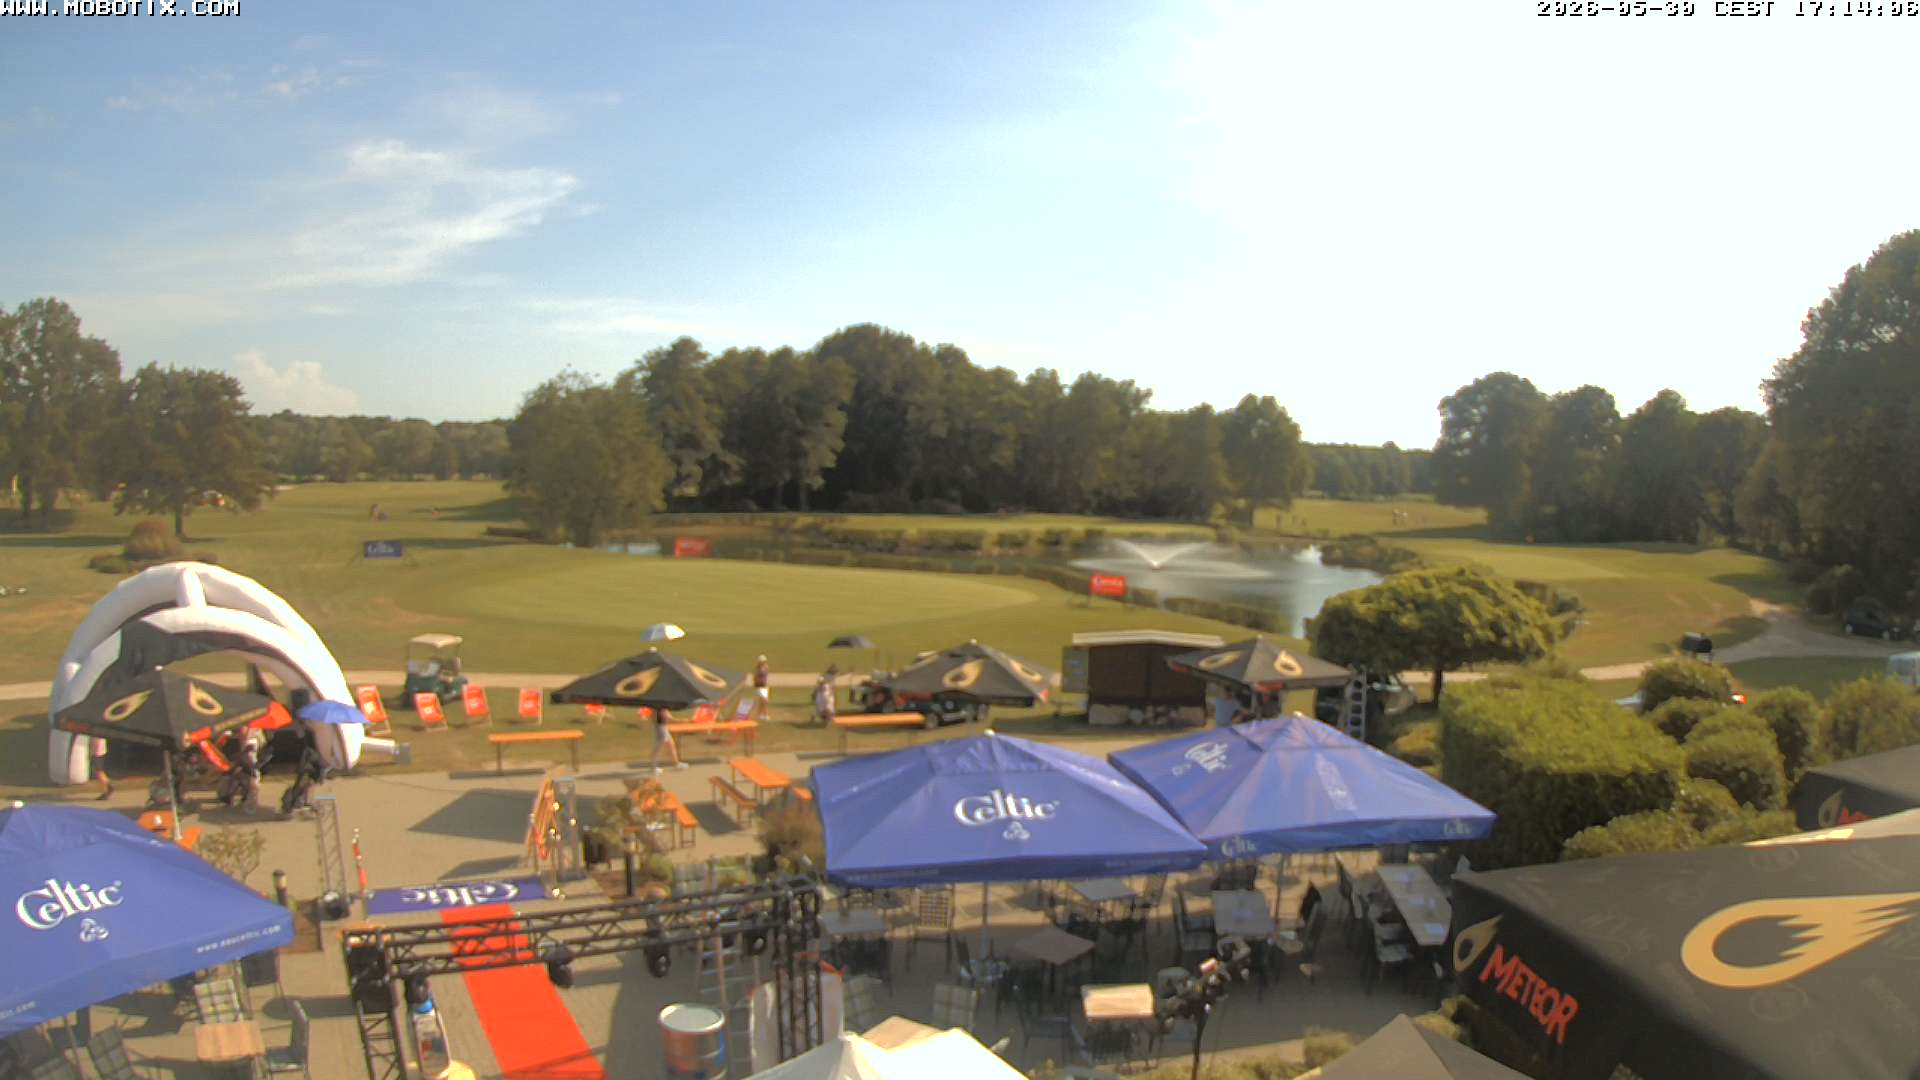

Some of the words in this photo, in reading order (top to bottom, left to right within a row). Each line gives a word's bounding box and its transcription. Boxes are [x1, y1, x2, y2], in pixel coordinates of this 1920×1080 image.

[954, 788, 1057, 826] Celtic
[16, 878, 124, 930] Celtic
[400, 881, 519, 907] Celtic
[1478, 943, 1580, 1046] METEOR
